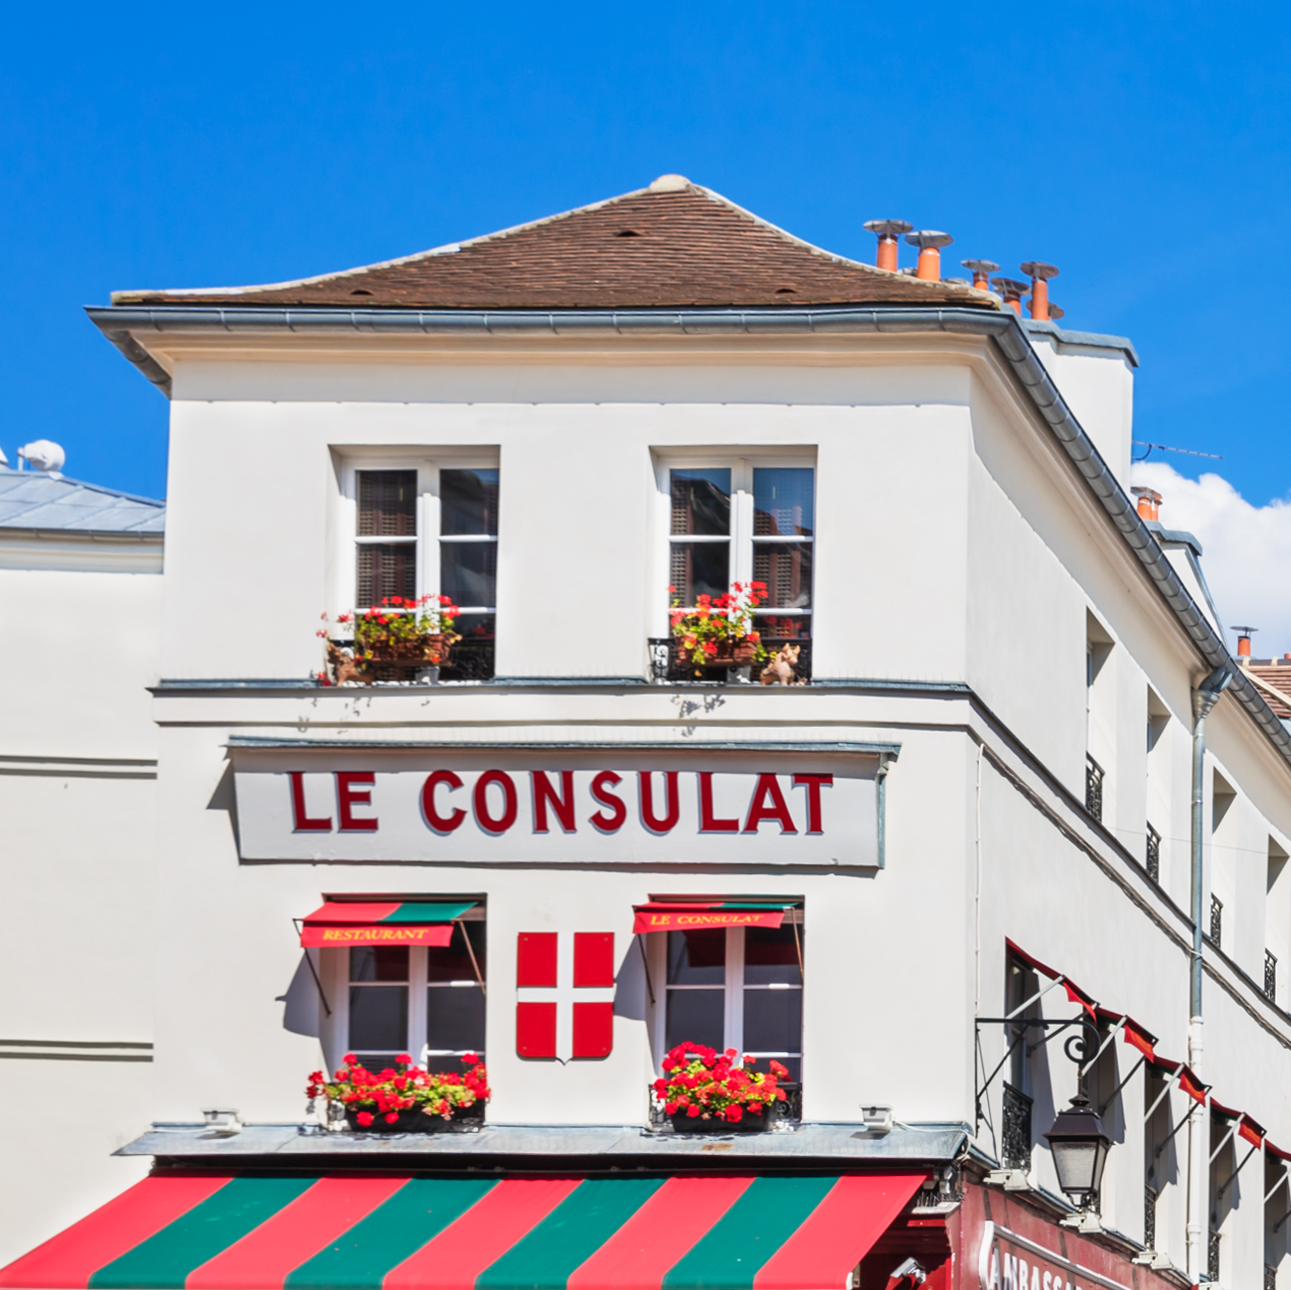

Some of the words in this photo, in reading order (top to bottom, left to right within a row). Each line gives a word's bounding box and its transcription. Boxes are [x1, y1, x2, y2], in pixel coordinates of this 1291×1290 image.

[289, 770, 380, 833] LE
[420, 769, 834, 835] CONSULAT
[651, 915, 671, 925] LE
[677, 914, 764, 925] CONSULAT
[322, 929, 428, 940] RESTAURANT
